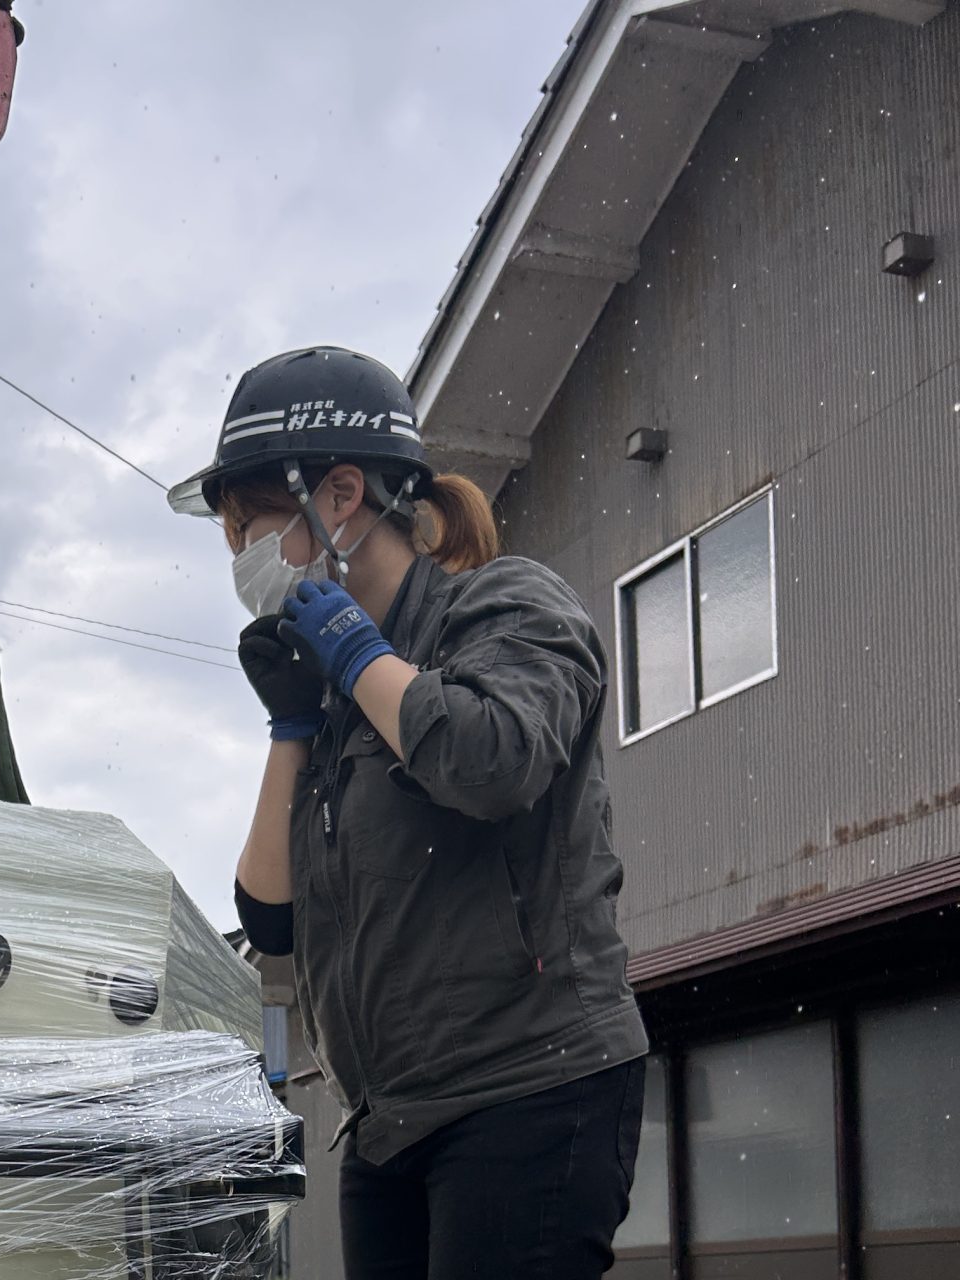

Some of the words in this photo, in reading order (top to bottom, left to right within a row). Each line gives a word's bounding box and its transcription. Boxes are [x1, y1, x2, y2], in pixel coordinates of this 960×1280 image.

[290, 400, 335, 412] 株式会社
[286, 410, 386, 432] 村上キカイ
